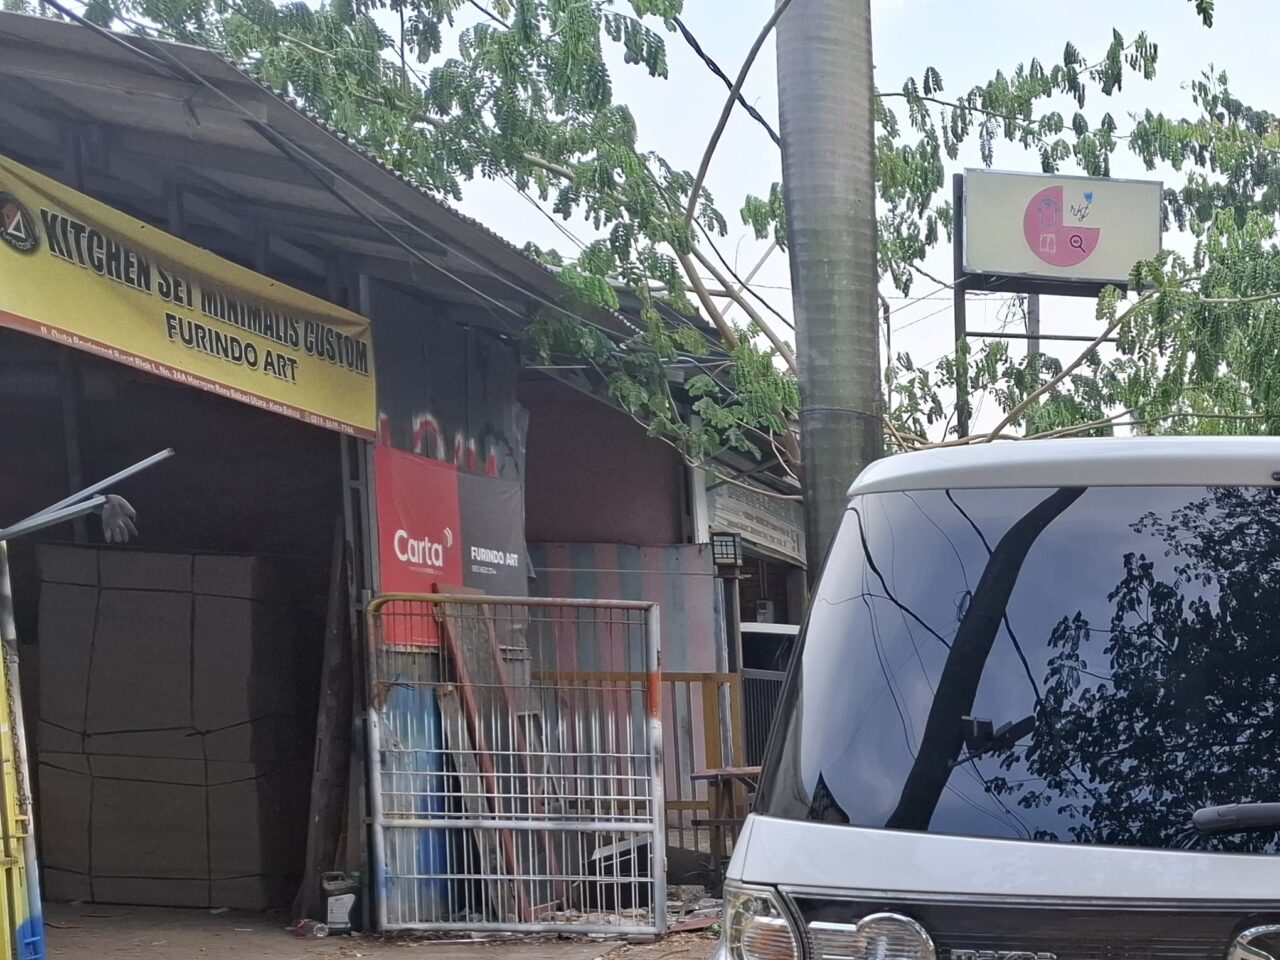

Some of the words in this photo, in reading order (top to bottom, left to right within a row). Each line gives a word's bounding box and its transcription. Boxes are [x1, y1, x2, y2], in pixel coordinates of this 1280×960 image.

[39, 207, 152, 295] KITCHEN
[157, 264, 194, 310] SET
[200, 288, 300, 351] MINIMALIS
[303, 318, 369, 376] CUSTOM
[164, 311, 259, 371] FURINDO
[262, 347, 298, 384] ART
[394, 529, 443, 567] Carta
[471, 546, 504, 565] FURINDO
[505, 553, 519, 567] ART
